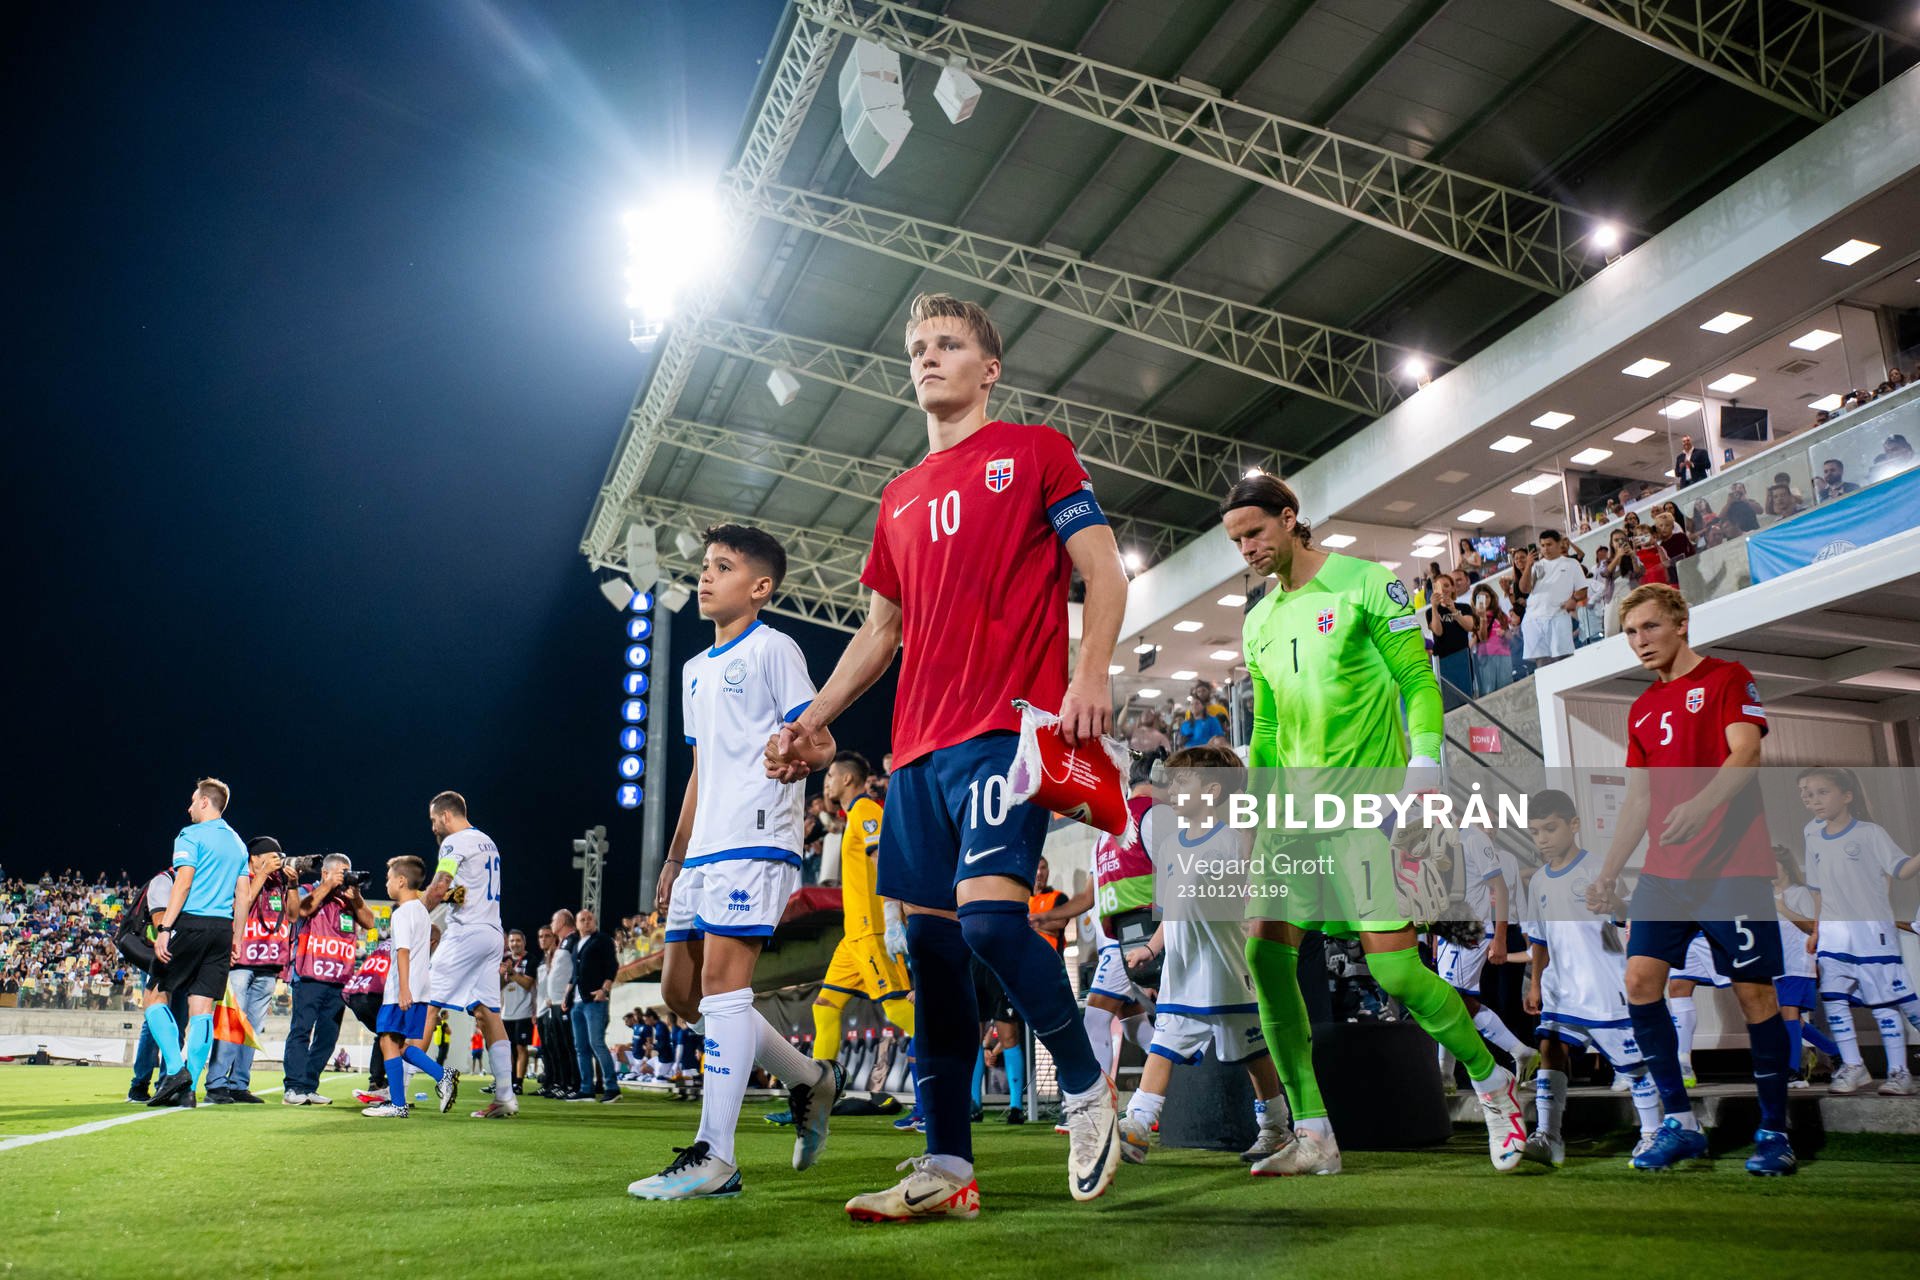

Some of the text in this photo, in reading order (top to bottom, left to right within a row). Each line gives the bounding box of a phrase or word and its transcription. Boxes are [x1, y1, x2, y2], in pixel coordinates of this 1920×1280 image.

[927, 489, 961, 543] 10
[1055, 503, 1092, 528] RESPECT
[1290, 637, 1299, 674] 1
[1660, 710, 1673, 746] 5
[968, 774, 1009, 830] 10
[1360, 860, 1372, 901] 1
[728, 902, 751, 912] errea
[243, 919, 289, 939] HOTO
[1734, 914, 1755, 951] 5
[245, 943, 280, 960] 623
[1450, 950, 1459, 969] 7
[312, 960, 345, 979] 627
[869, 955, 880, 976] 1
